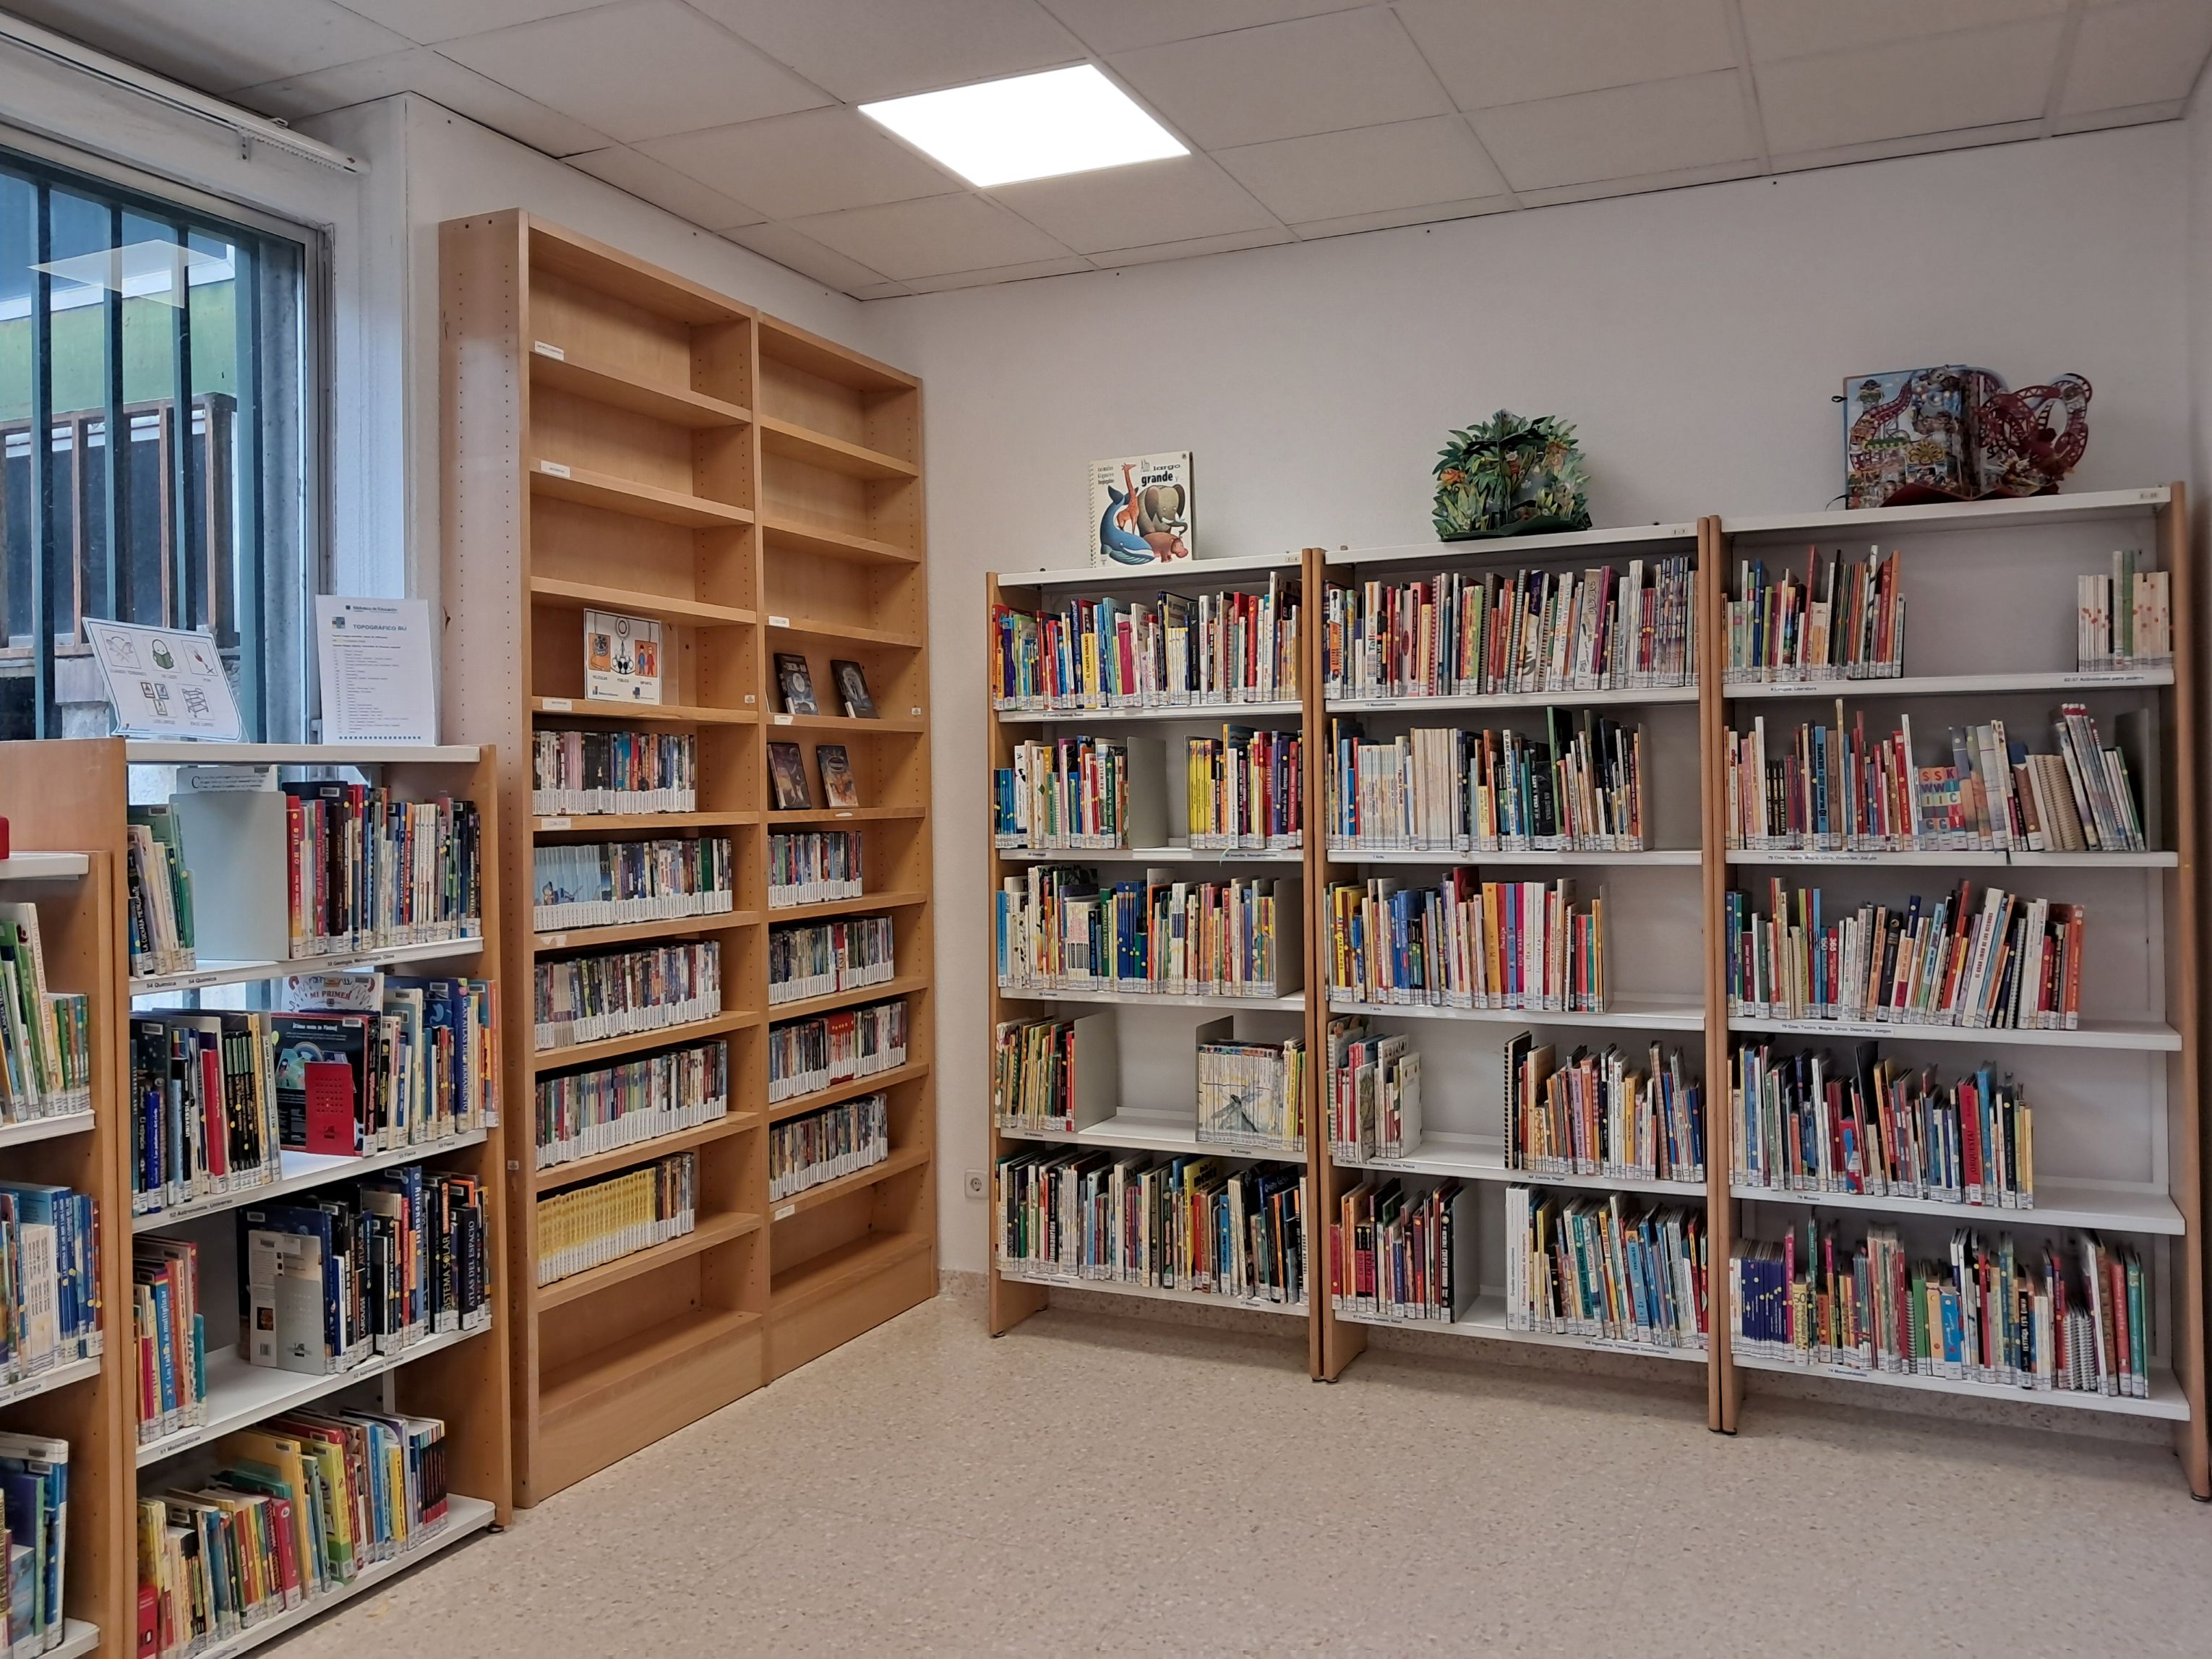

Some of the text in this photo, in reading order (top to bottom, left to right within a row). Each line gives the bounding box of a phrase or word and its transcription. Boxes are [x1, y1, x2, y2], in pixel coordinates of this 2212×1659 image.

[1141, 471, 1173, 487] grande
[138, 919, 148, 943] CUCHARA
[310, 989, 351, 1000] MI PRIMER
[210, 1199, 233, 1209] Universo
[443, 1269, 452, 1311] SISTEMA
[1792, 1292, 1806, 1304] 50
[161, 1290, 170, 1333] multiplicar
